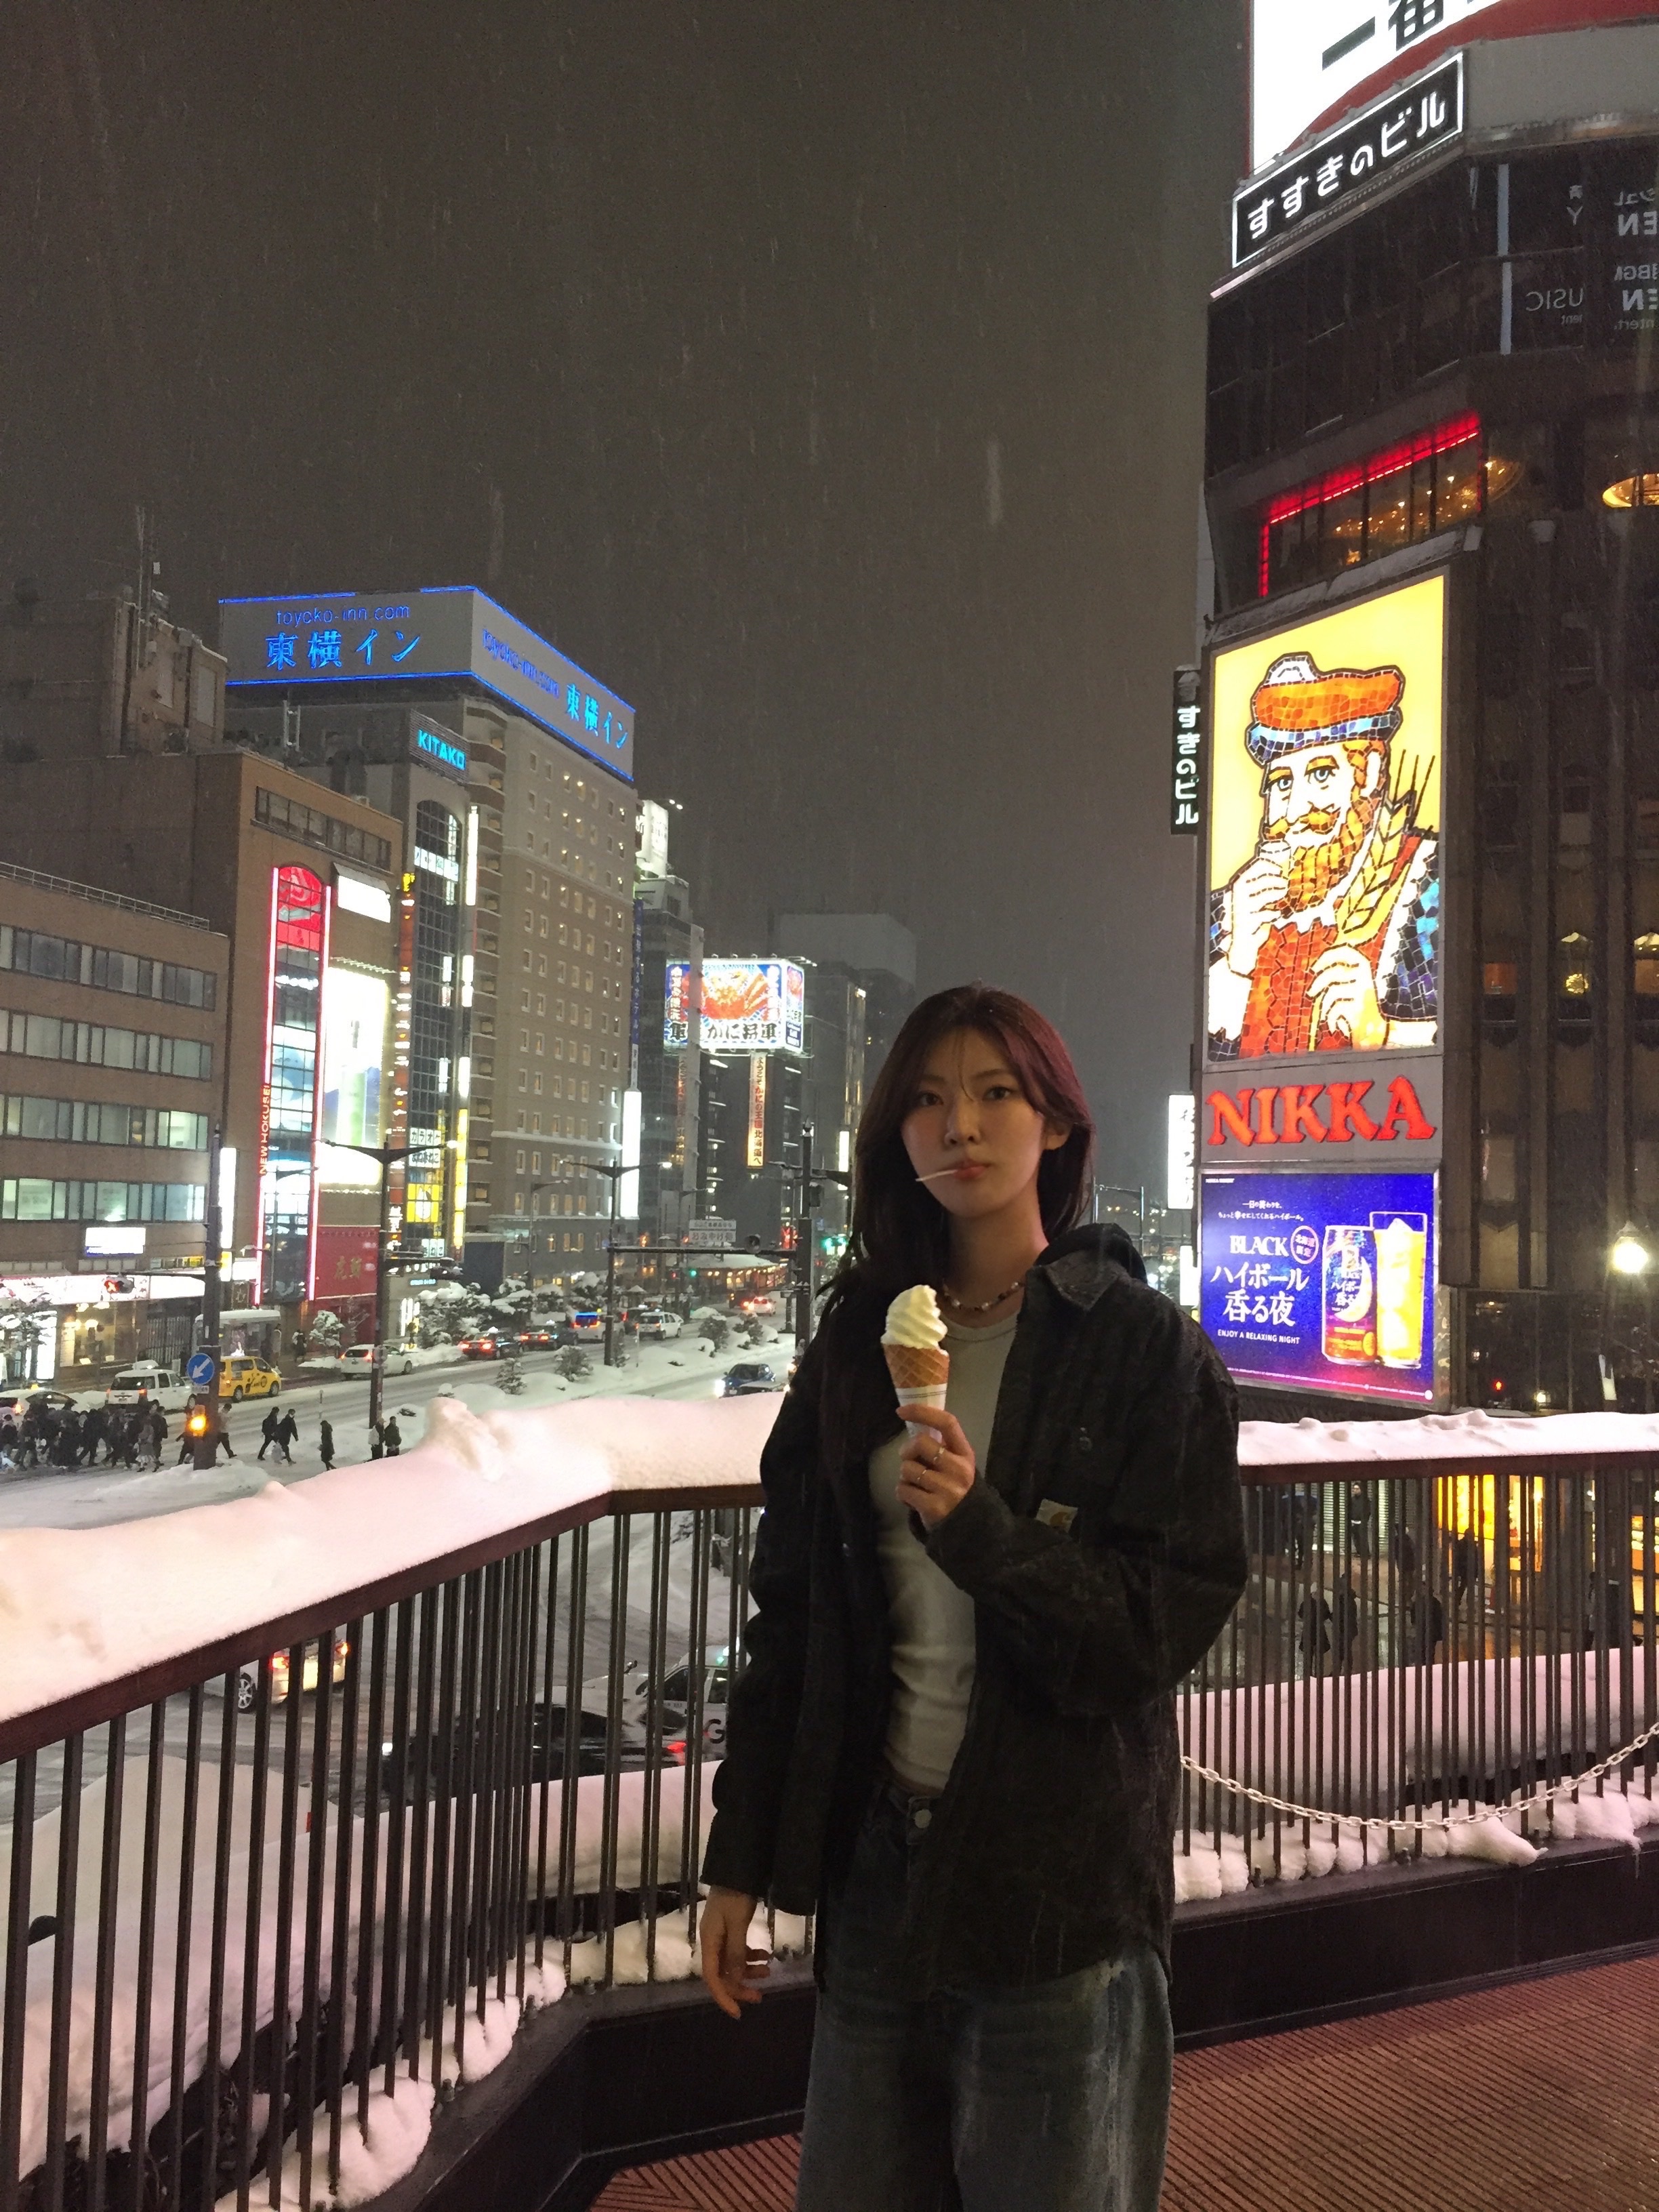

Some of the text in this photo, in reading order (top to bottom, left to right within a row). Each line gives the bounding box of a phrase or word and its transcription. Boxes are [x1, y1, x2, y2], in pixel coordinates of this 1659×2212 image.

[1247, 90, 1446, 239] すすきのビル
[265, 628, 421, 671] 東横イン
[566, 682, 629, 749] 東横イン
[417, 729, 466, 771] KITAKO
[708, 1023, 777, 1040] かに将軍
[260, 1085, 270, 1174] NEW HOKUSEI
[1206, 1075, 1437, 1147] NIKKA
[1229, 1235, 1290, 1257] BLACK
[1210, 1261, 1310, 1291] ハイボール
[1223, 1288, 1296, 1327] 香る夜
[1217, 1329, 1239, 1338] ENJOY
[1246, 1332, 1277, 1343] RELAXING
[1279, 1336, 1300, 1345] NIGHT
